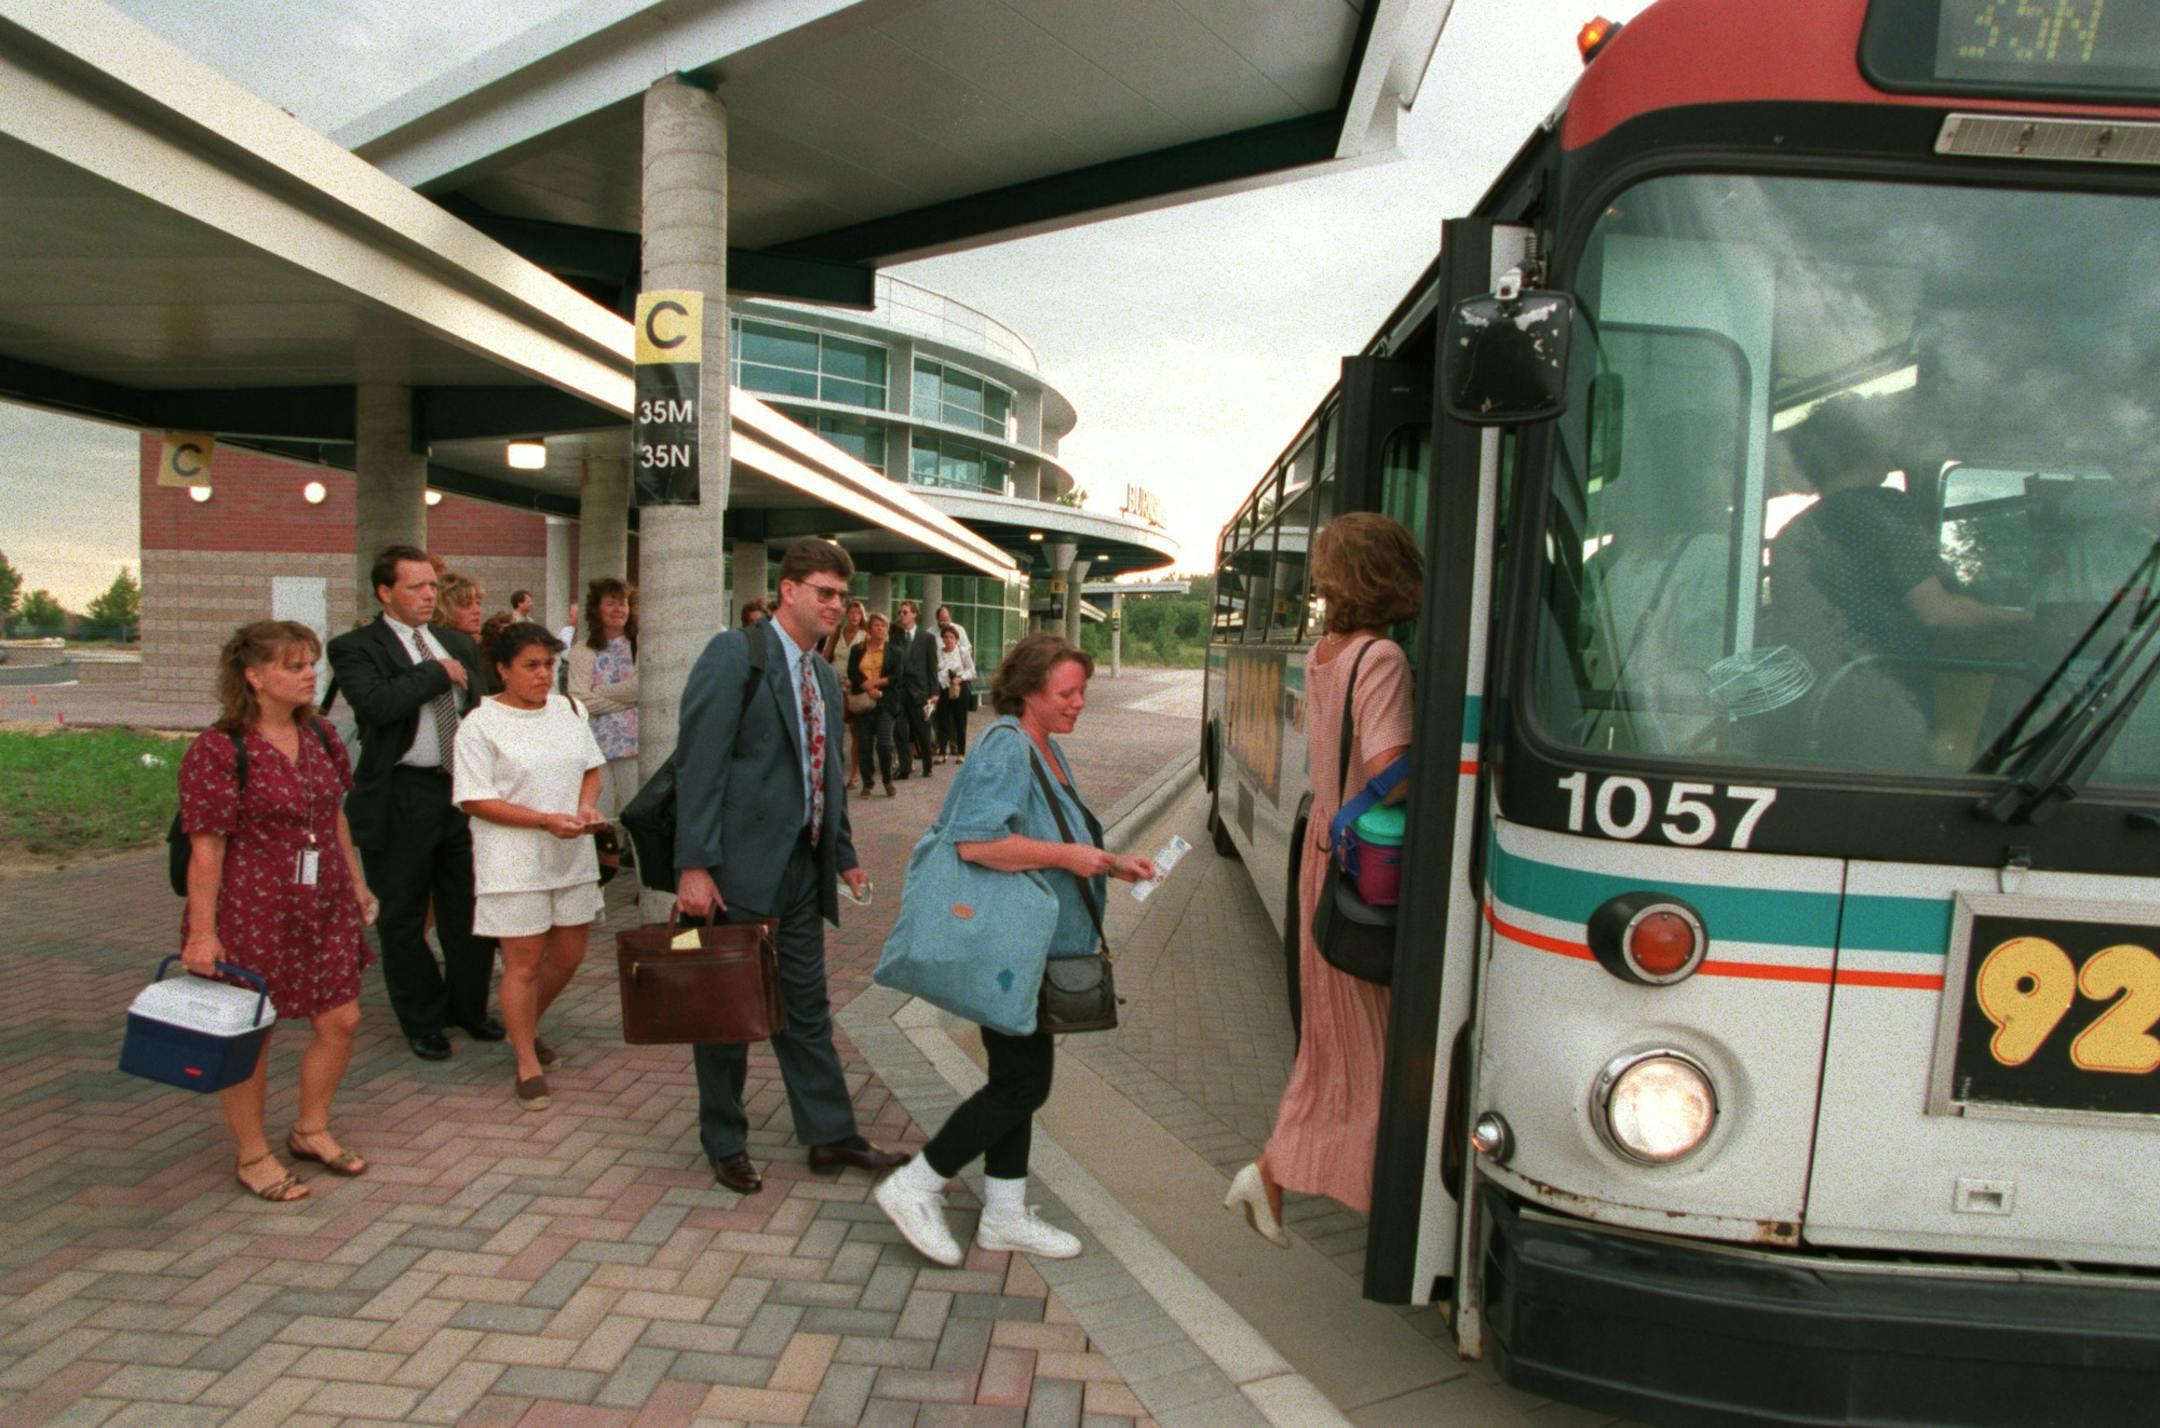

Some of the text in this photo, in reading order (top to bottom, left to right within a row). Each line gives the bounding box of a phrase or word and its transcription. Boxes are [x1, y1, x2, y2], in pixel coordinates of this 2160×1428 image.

[1957, 0, 2104, 61] 35N
[645, 300, 689, 350] C
[639, 399, 692, 425] 35M
[172, 442, 203, 478] C
[640, 444, 690, 469] 35N
[1557, 771, 1778, 849] 1057
[1976, 935, 2160, 1074] 92
